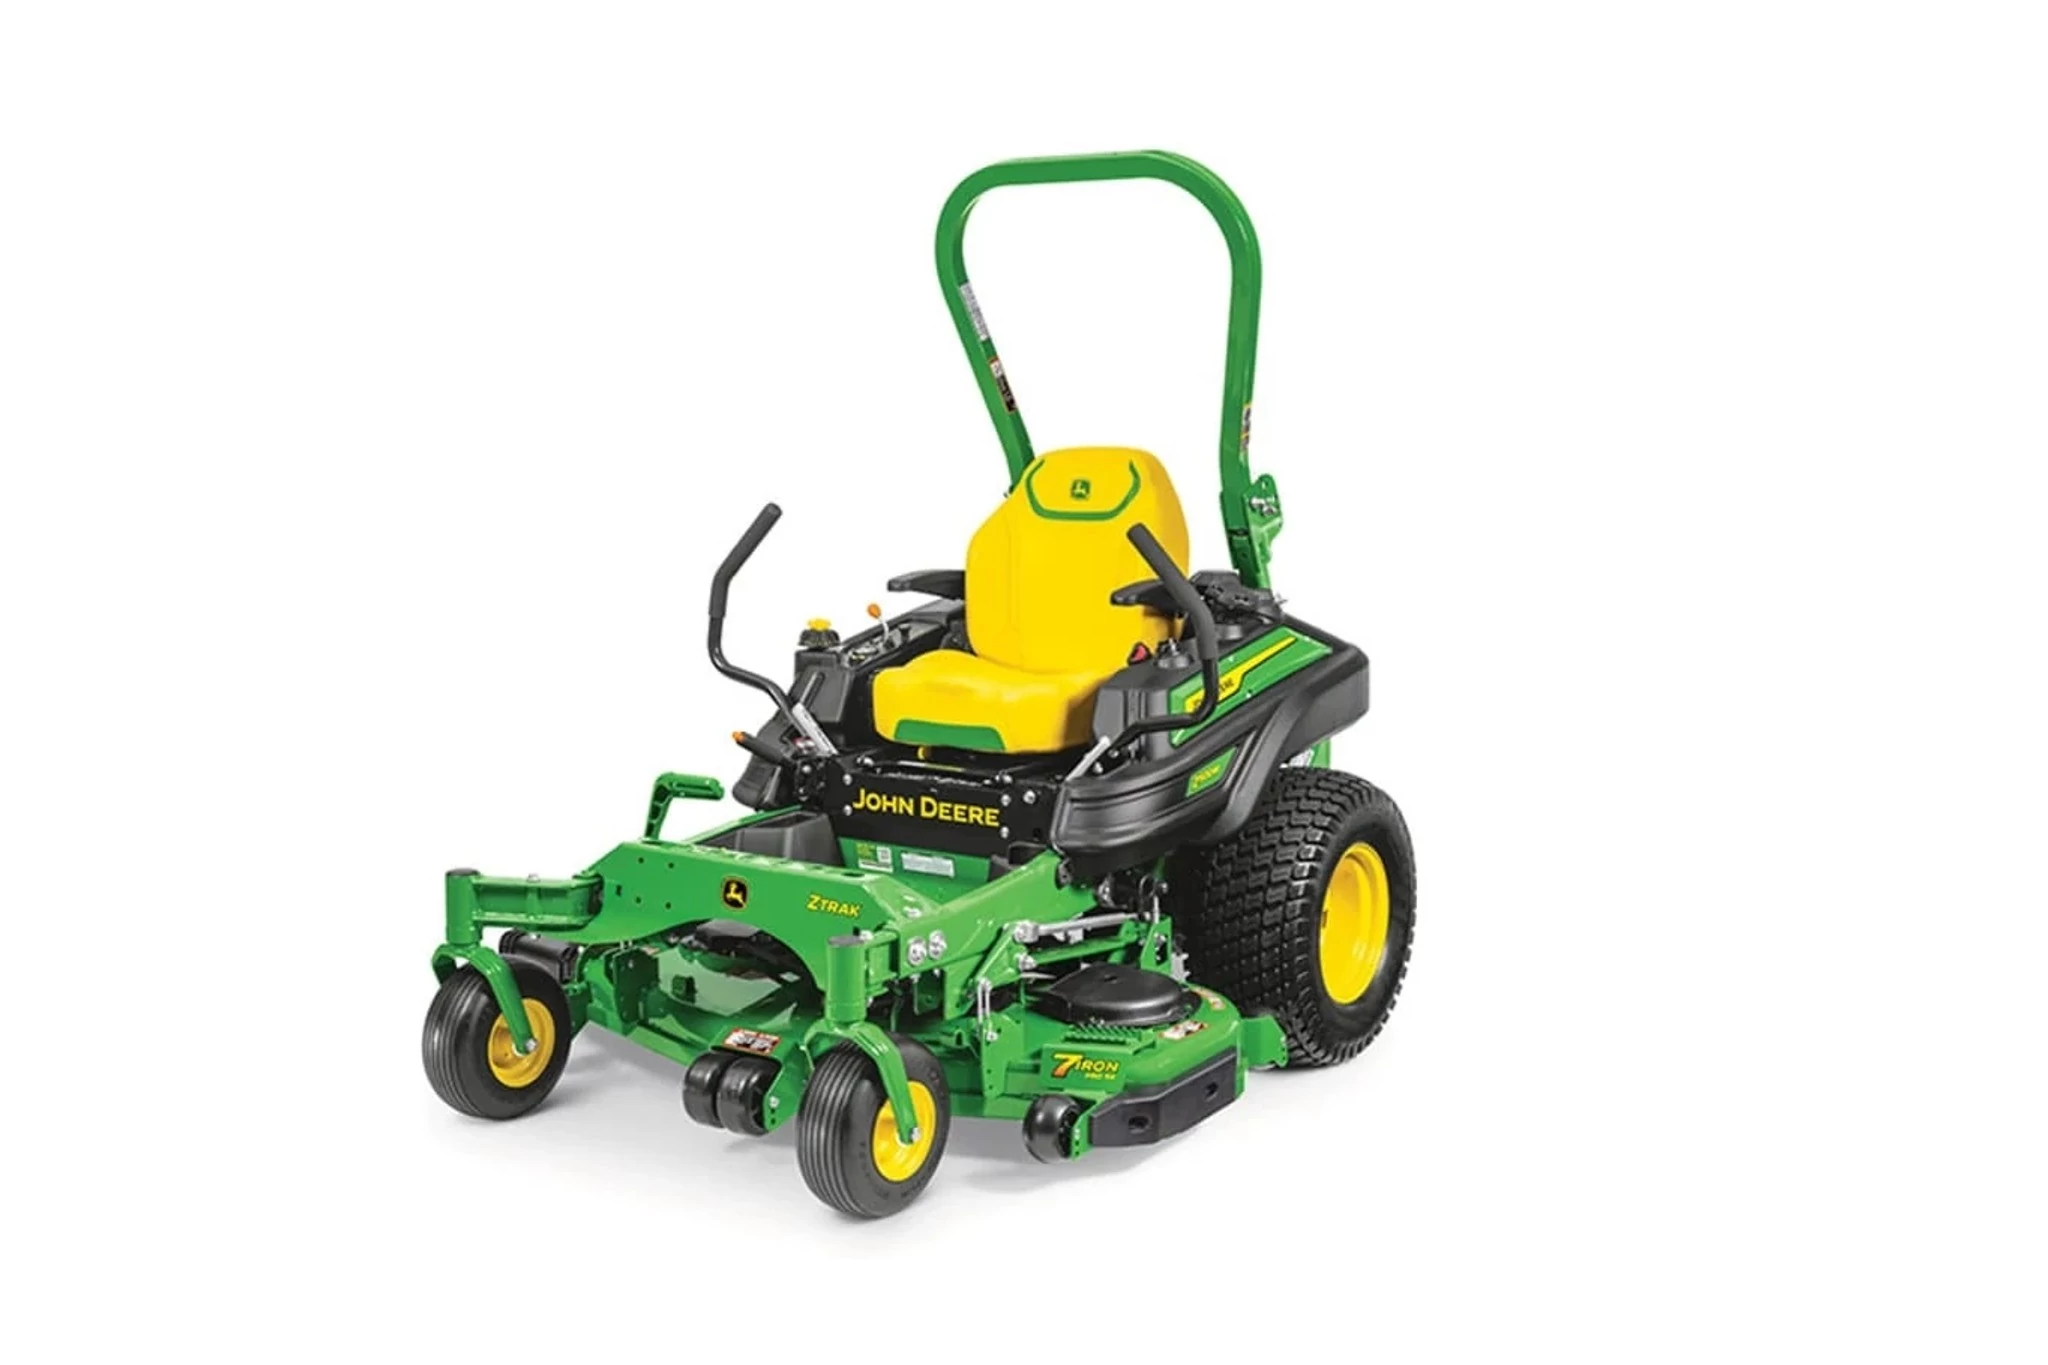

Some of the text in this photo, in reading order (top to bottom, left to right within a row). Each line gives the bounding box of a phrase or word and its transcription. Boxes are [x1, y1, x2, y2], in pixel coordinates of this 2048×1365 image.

[852, 788, 1000, 827] JOHN DEERE
[807, 894, 860, 917] ZTRAK
